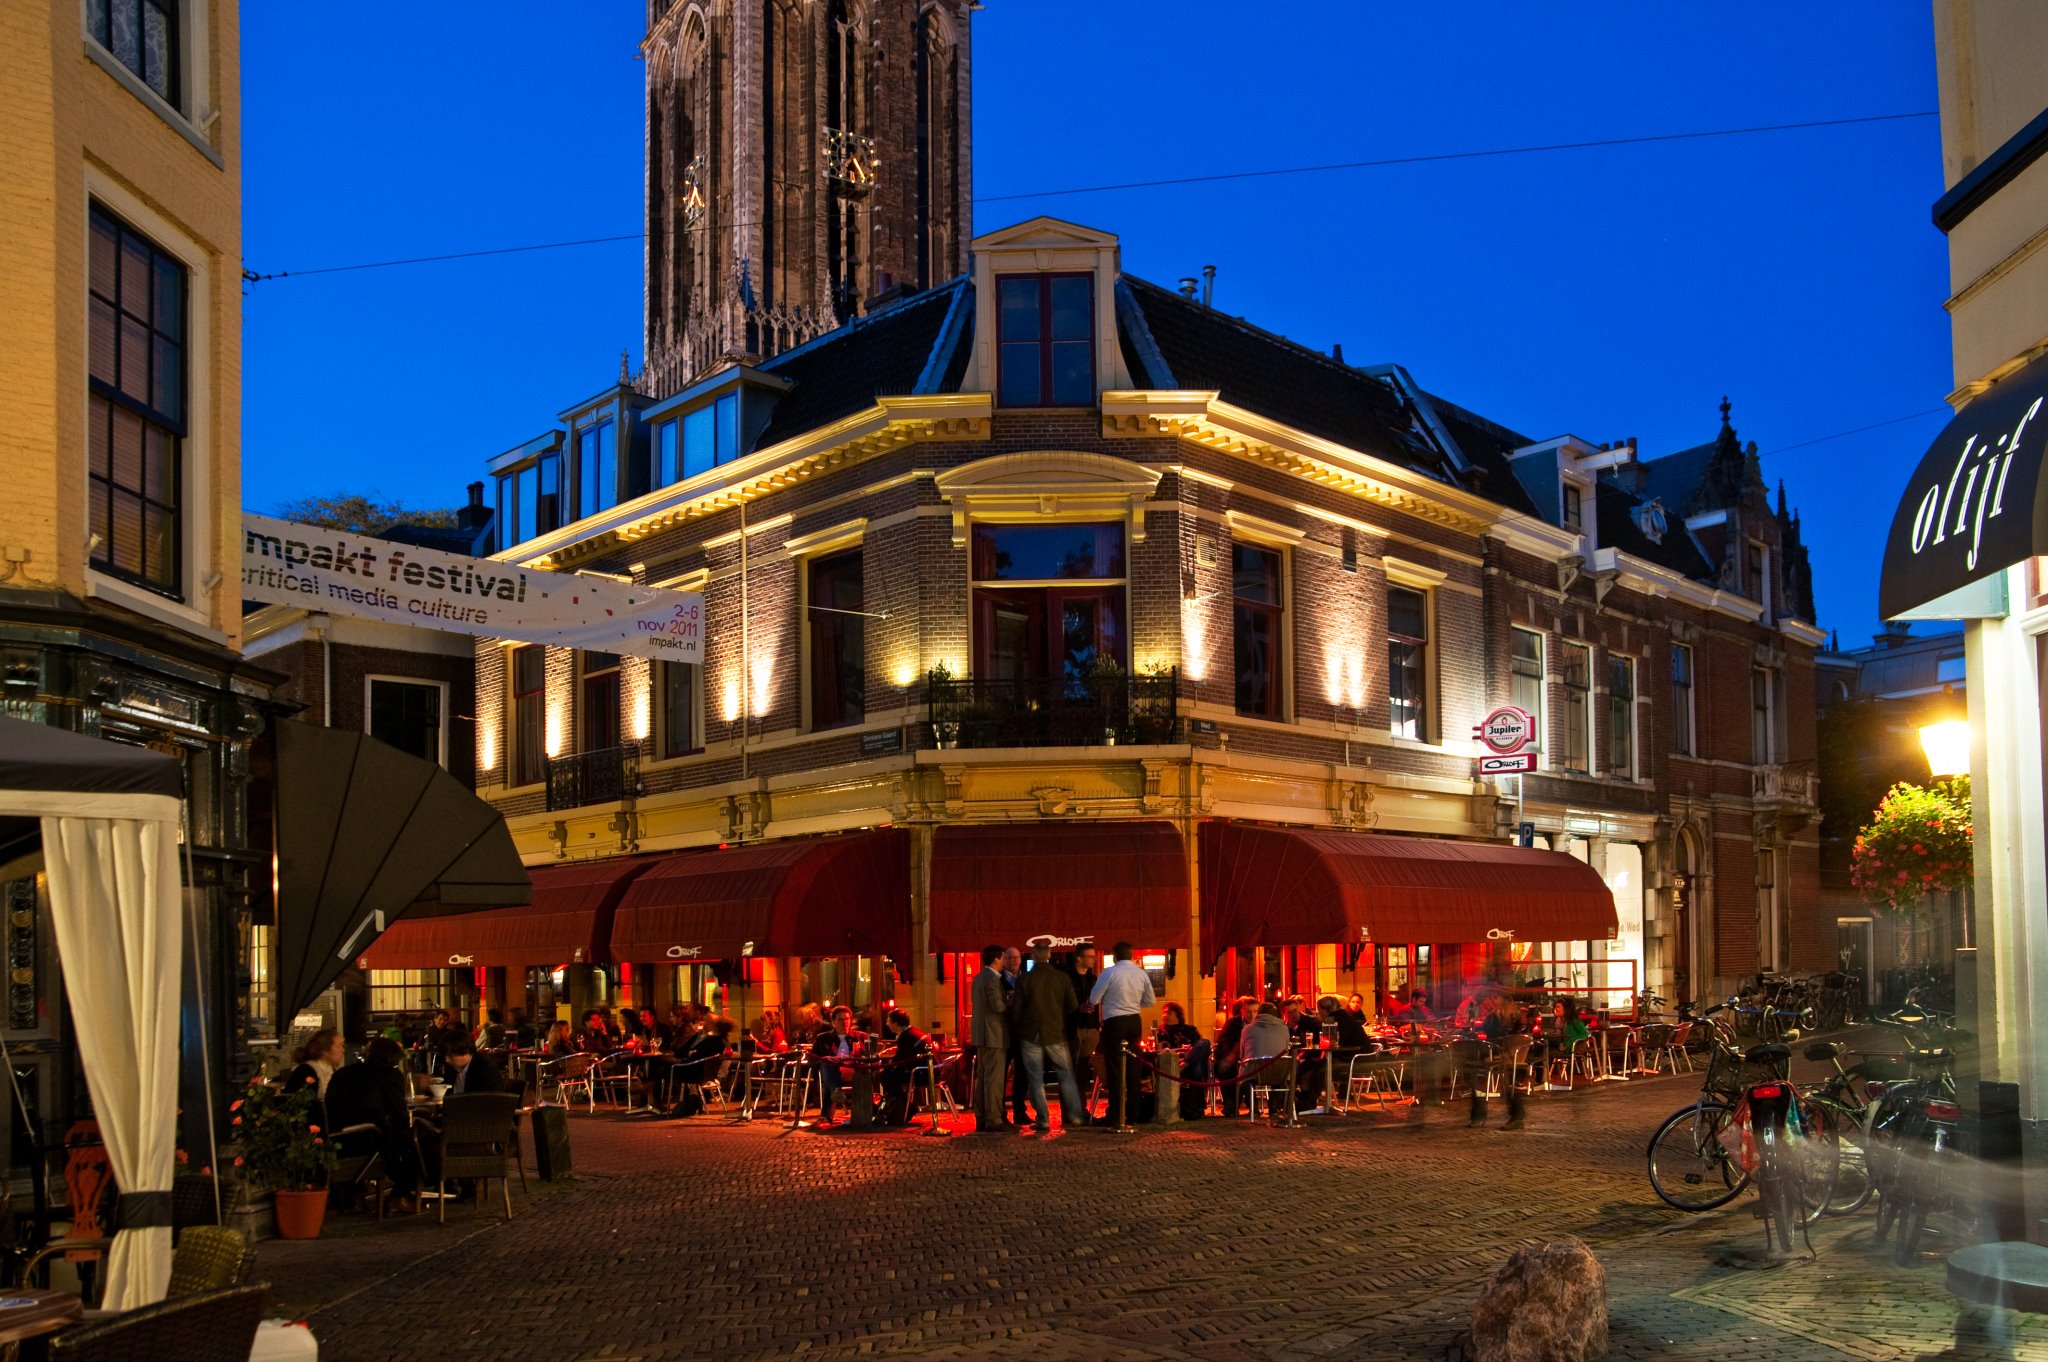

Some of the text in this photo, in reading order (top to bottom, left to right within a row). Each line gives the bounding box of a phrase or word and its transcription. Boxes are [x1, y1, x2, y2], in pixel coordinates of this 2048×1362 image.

[1911, 396, 2043, 572] olijf
[243, 530, 526, 603] mpakt festival
[328, 582, 399, 610] media
[408, 598, 488, 624] culture
[673, 604, 699, 619] 2-6
[637, 618, 698, 637] nov 2011
[649, 634, 697, 651] impakt.nl
[1489, 725, 1522, 735] Jupiler
[1523, 825, 1532, 846] P
